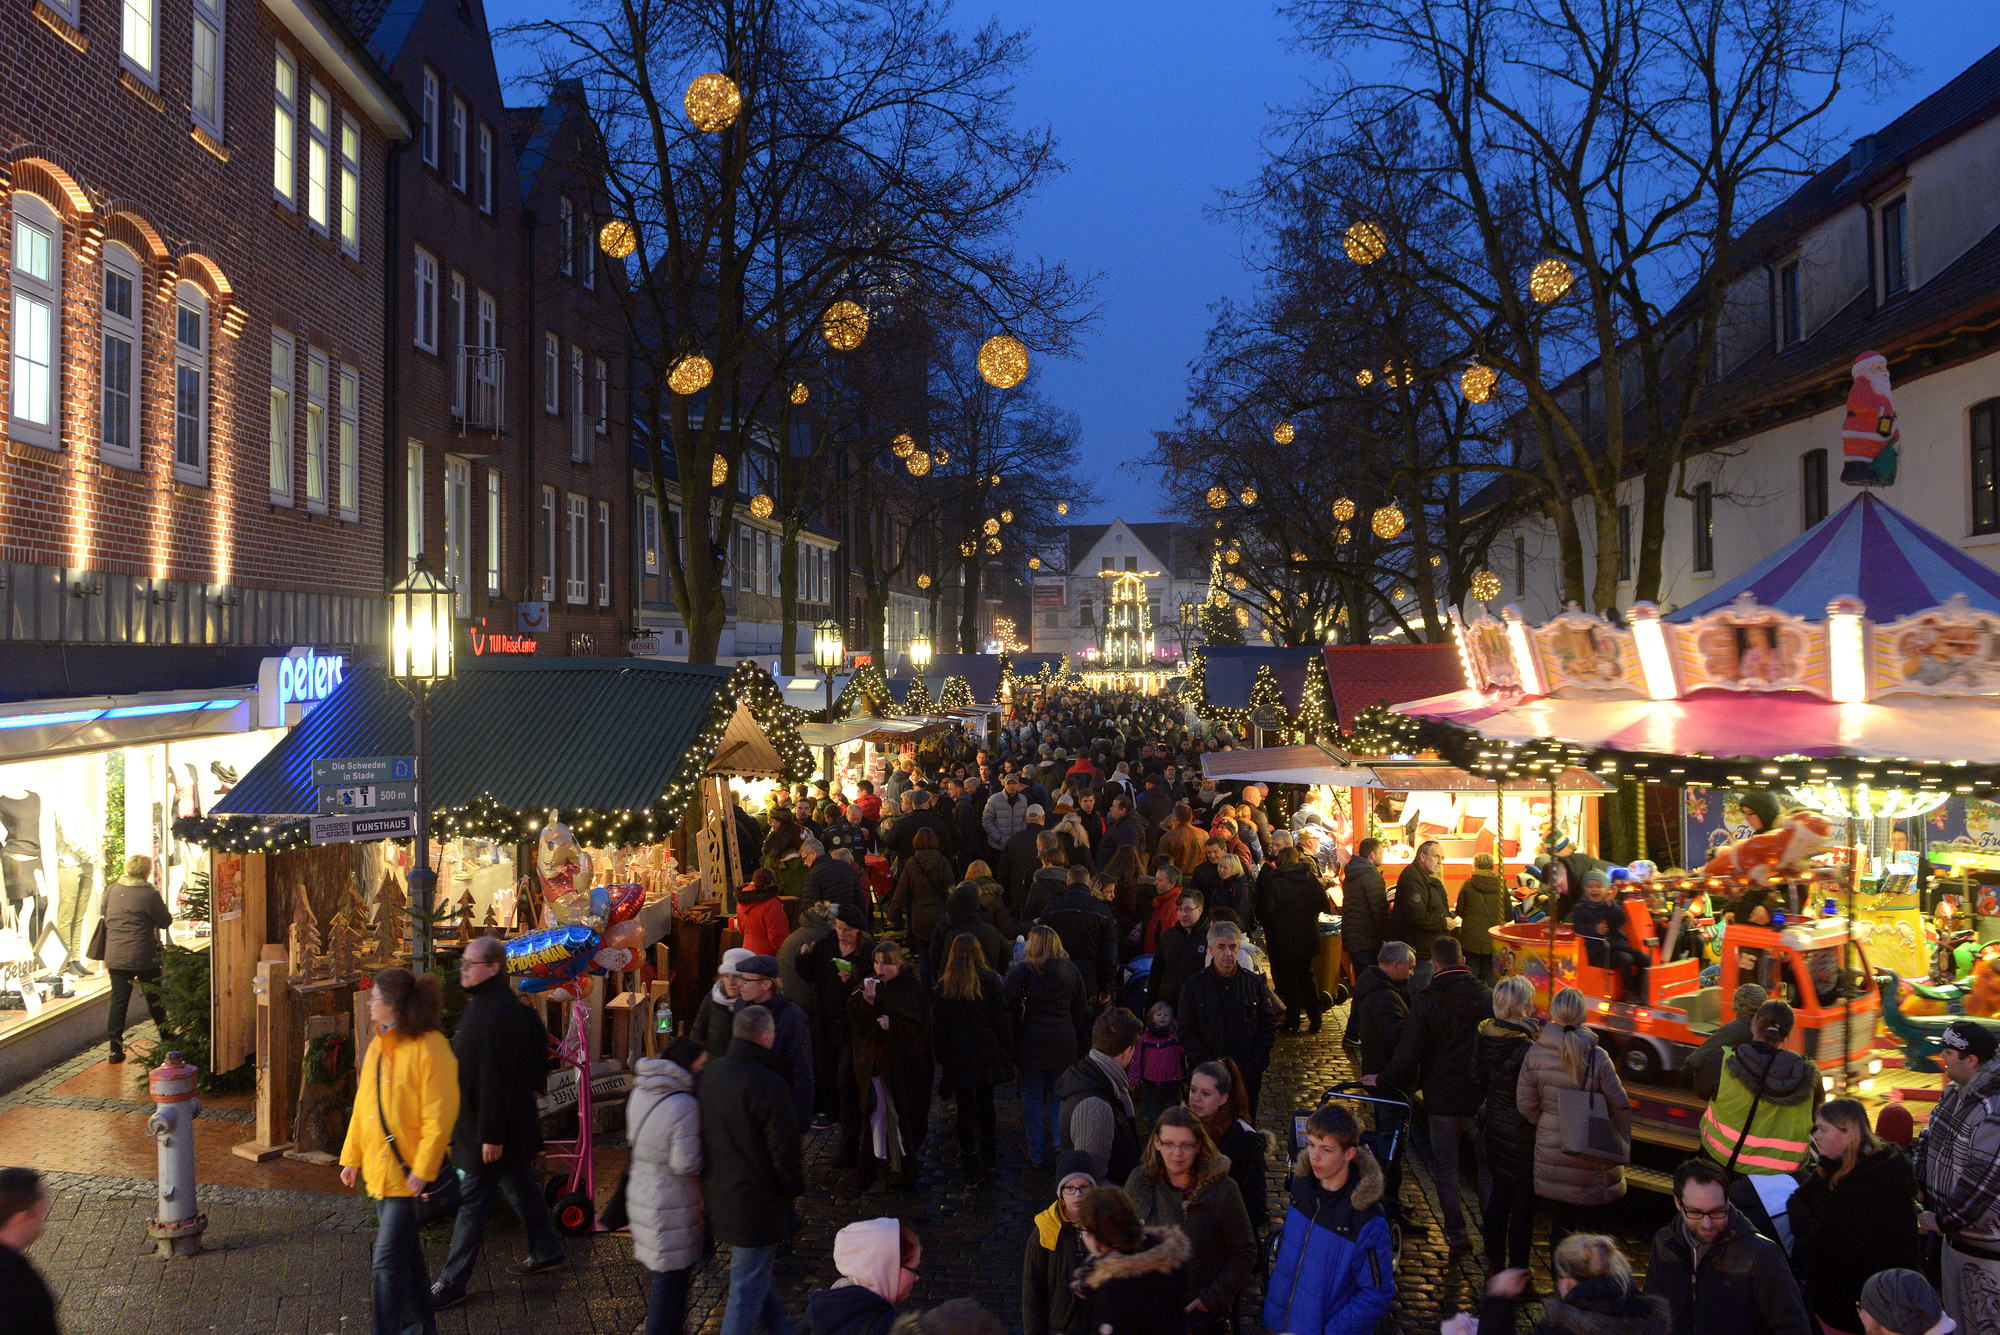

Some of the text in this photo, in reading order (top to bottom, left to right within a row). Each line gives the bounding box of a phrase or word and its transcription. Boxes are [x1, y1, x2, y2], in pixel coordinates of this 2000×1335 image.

[488, 634, 537, 653] TUI ReiseCenter
[332, 761, 387, 771] Die Schweden
[343, 772, 375, 780] in Stade
[380, 790, 406, 800] 500 m
[356, 819, 407, 832] KUNSTHAUS
